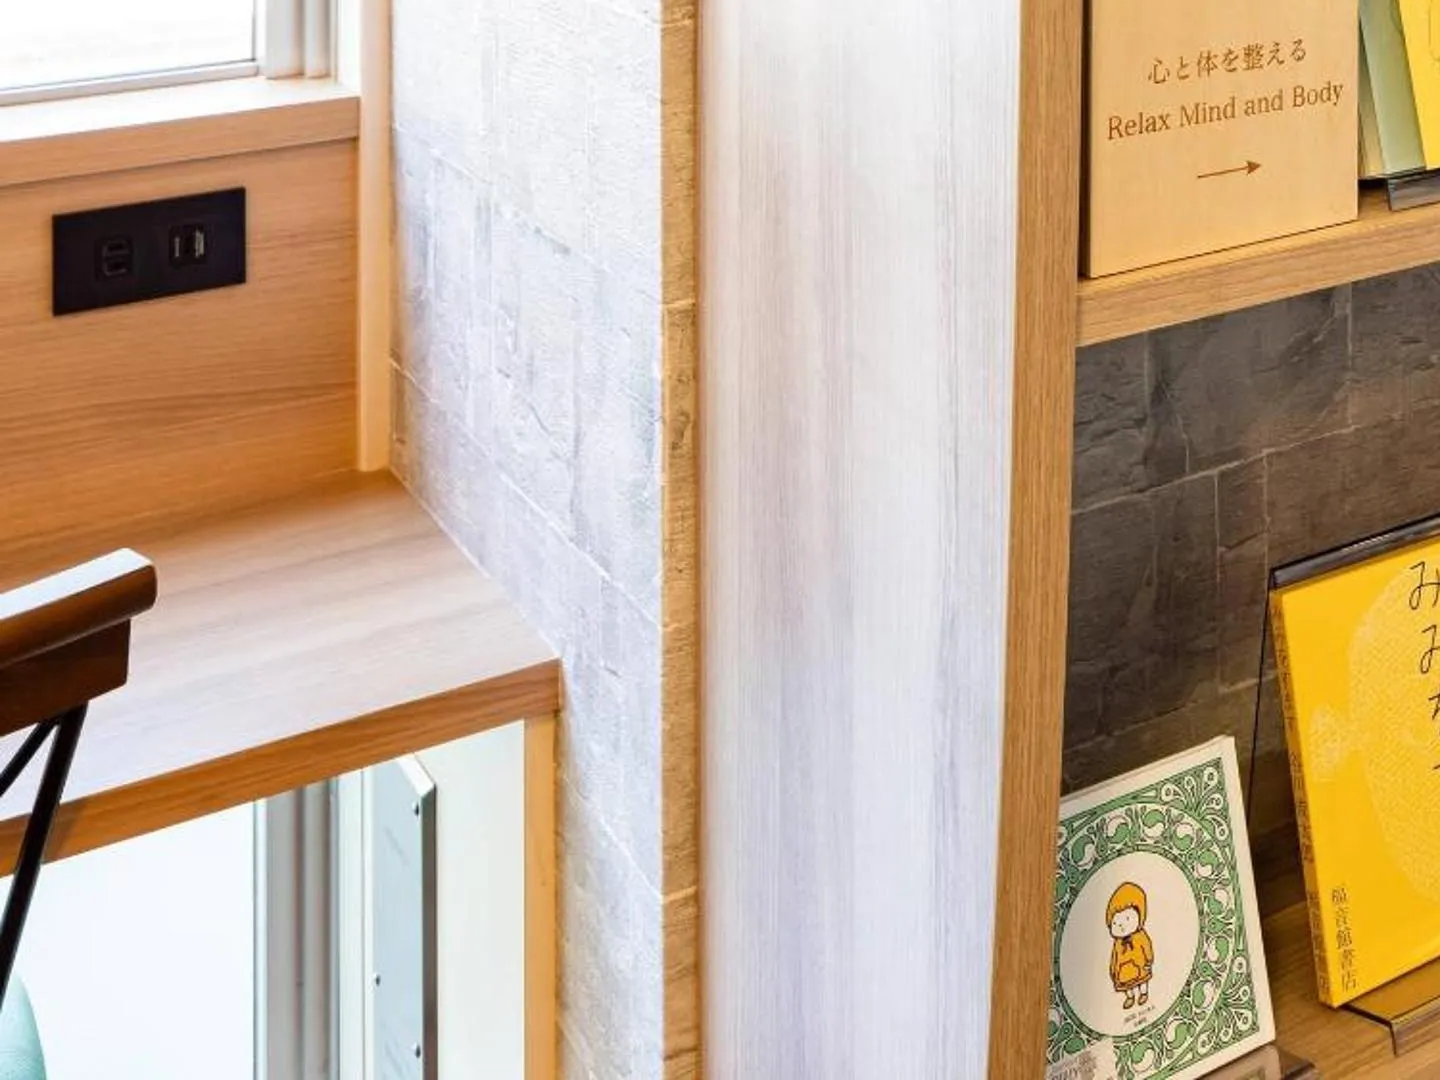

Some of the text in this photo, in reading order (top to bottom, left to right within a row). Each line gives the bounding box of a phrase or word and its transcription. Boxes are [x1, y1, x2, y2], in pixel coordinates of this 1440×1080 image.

[1147, 38, 1308, 86] 心と体を整える
[1106, 79, 1345, 141] Relax Mind and Body
